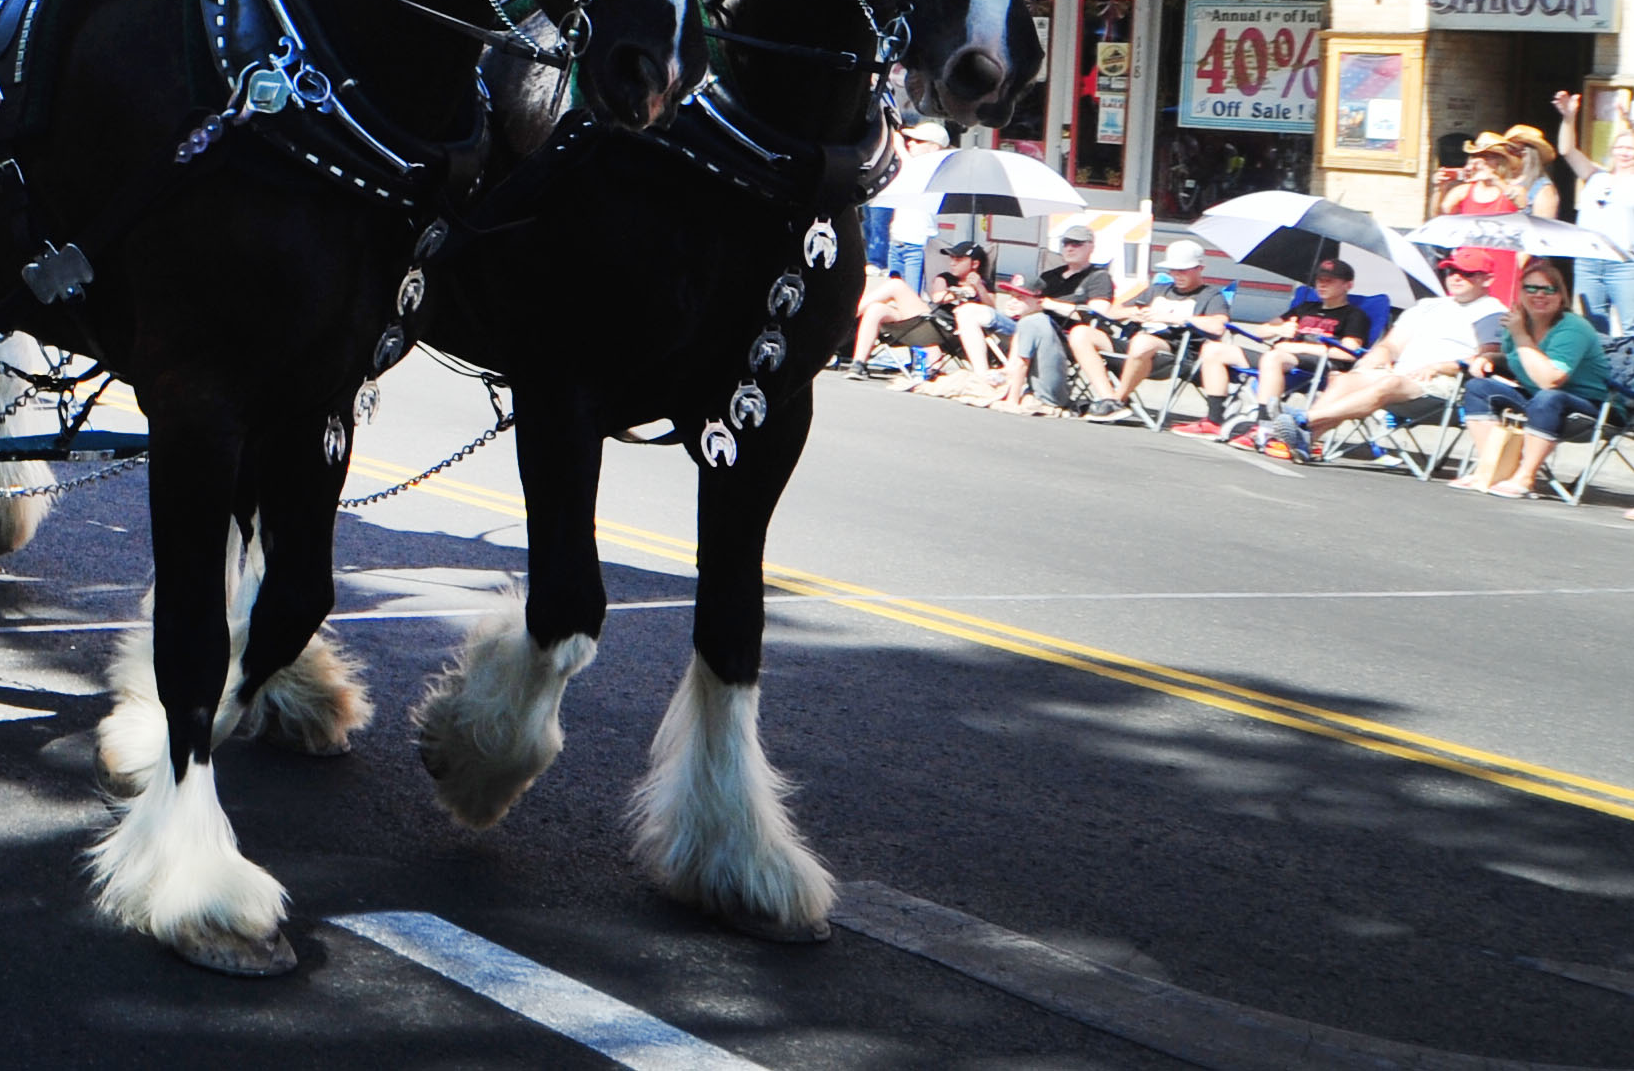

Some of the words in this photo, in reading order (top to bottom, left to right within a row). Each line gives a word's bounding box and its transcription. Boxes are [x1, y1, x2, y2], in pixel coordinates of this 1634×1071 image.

[1212, 9, 1261, 22] Annual
[1282, 10, 1298, 23] of
[1212, 100, 1242, 117] Off
[1251, 102, 1292, 120] Sale
